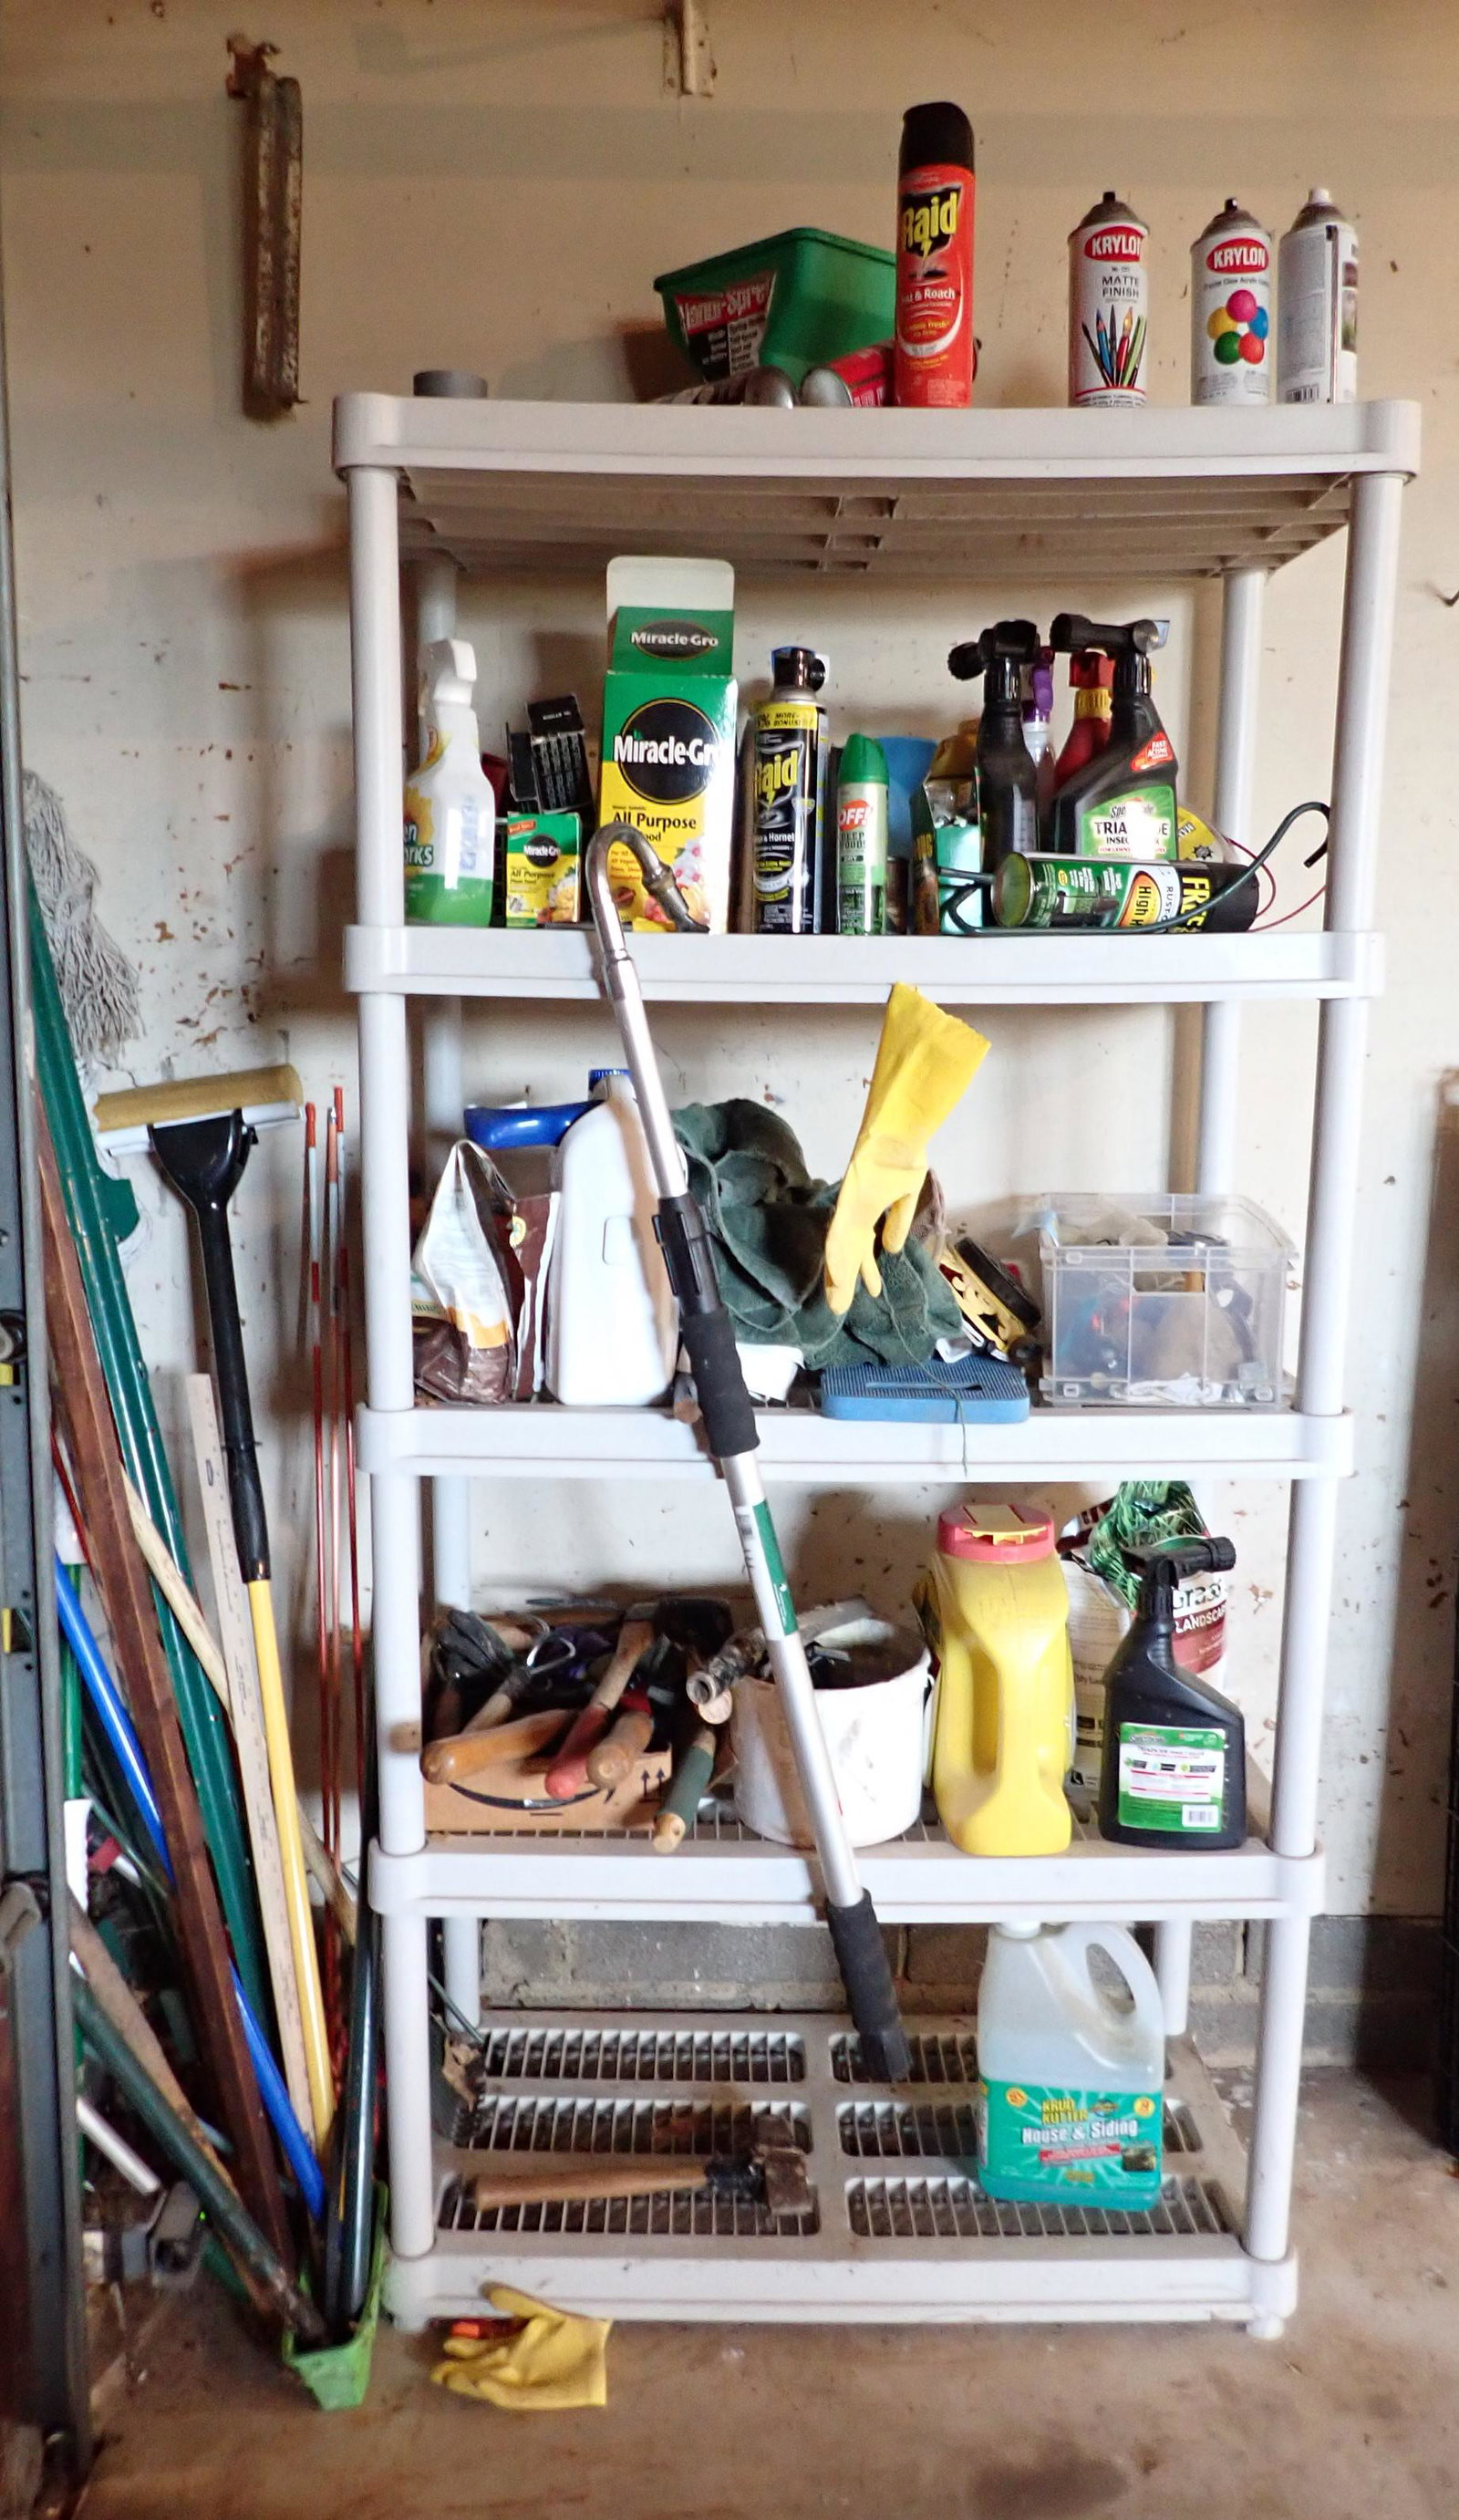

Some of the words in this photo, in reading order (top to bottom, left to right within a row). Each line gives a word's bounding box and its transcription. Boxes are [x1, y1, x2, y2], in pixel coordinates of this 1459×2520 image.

[900, 192, 957, 250] Raid
[1214, 247, 1266, 269] KRYLON
[1102, 275, 1139, 287] MATTE
[1102, 286, 1139, 298] FINISH
[924, 286, 956, 300] Roach
[614, 735, 720, 765] Miracle-Gr
[614, 812, 632, 824] All
[637, 813, 697, 834] Purpose
[1135, 886, 1152, 917] High
[1162, 886, 1174, 921] RUST-O
[1021, 2128, 1069, 2144] House
[1071, 2125, 1086, 2141] &
[1090, 2119, 1138, 2139] Siding
